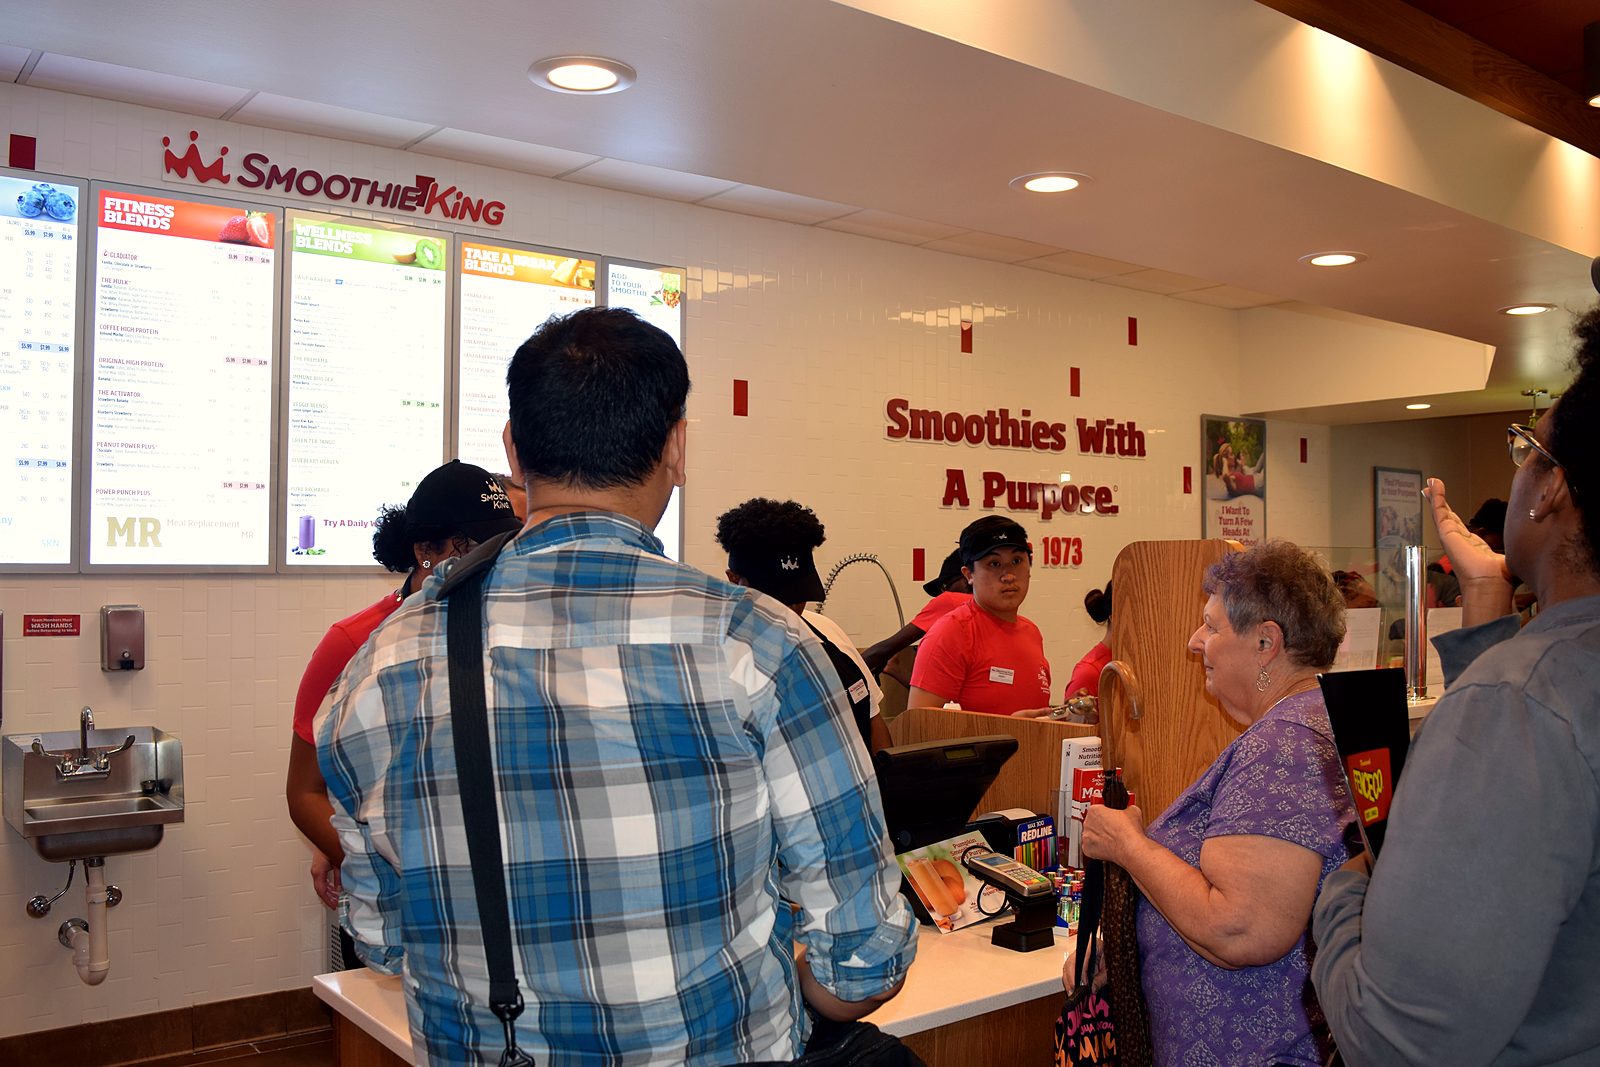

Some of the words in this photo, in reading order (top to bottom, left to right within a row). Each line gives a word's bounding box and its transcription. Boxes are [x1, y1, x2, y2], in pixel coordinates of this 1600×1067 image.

[237, 152, 424, 212] SMOOTHIE
[104, 196, 175, 218] FITNESS
[104, 209, 171, 230] BLENDS
[295, 223, 373, 245] WELLNESS
[295, 235, 353, 254] BLENDS
[109, 251, 138, 261] GLADIATOR
[464, 247, 499, 263] TAKE
[501, 252, 512, 264] A
[464, 258, 515, 276] BLENDS
[98, 357, 125, 365] ORIGINAL
[140, 360, 164, 368] PROTEIN
[886, 398, 1067, 451] Smoothies
[1076, 417, 1147, 457] With
[942, 468, 970, 507] A
[1225, 505, 1242, 515] Want
[1242, 506, 1250, 516] To
[166, 519, 186, 527] Meal
[188, 519, 240, 529] Replacement
[323, 519, 338, 528] Try
[347, 518, 369, 528] Daily
[1218, 516, 1234, 526] Turn
[1234, 517, 1240, 526] A
[1240, 517, 1253, 526] Few
[106, 516, 163, 547] MR
[241, 531, 254, 539] MR
[1222, 527, 1242, 537] Heads
[1242, 528, 1250, 537] At
[1042, 536, 1083, 567] 1973
[1021, 825, 1053, 843] REDLINE
[952, 838, 977, 849] Pumpkin
